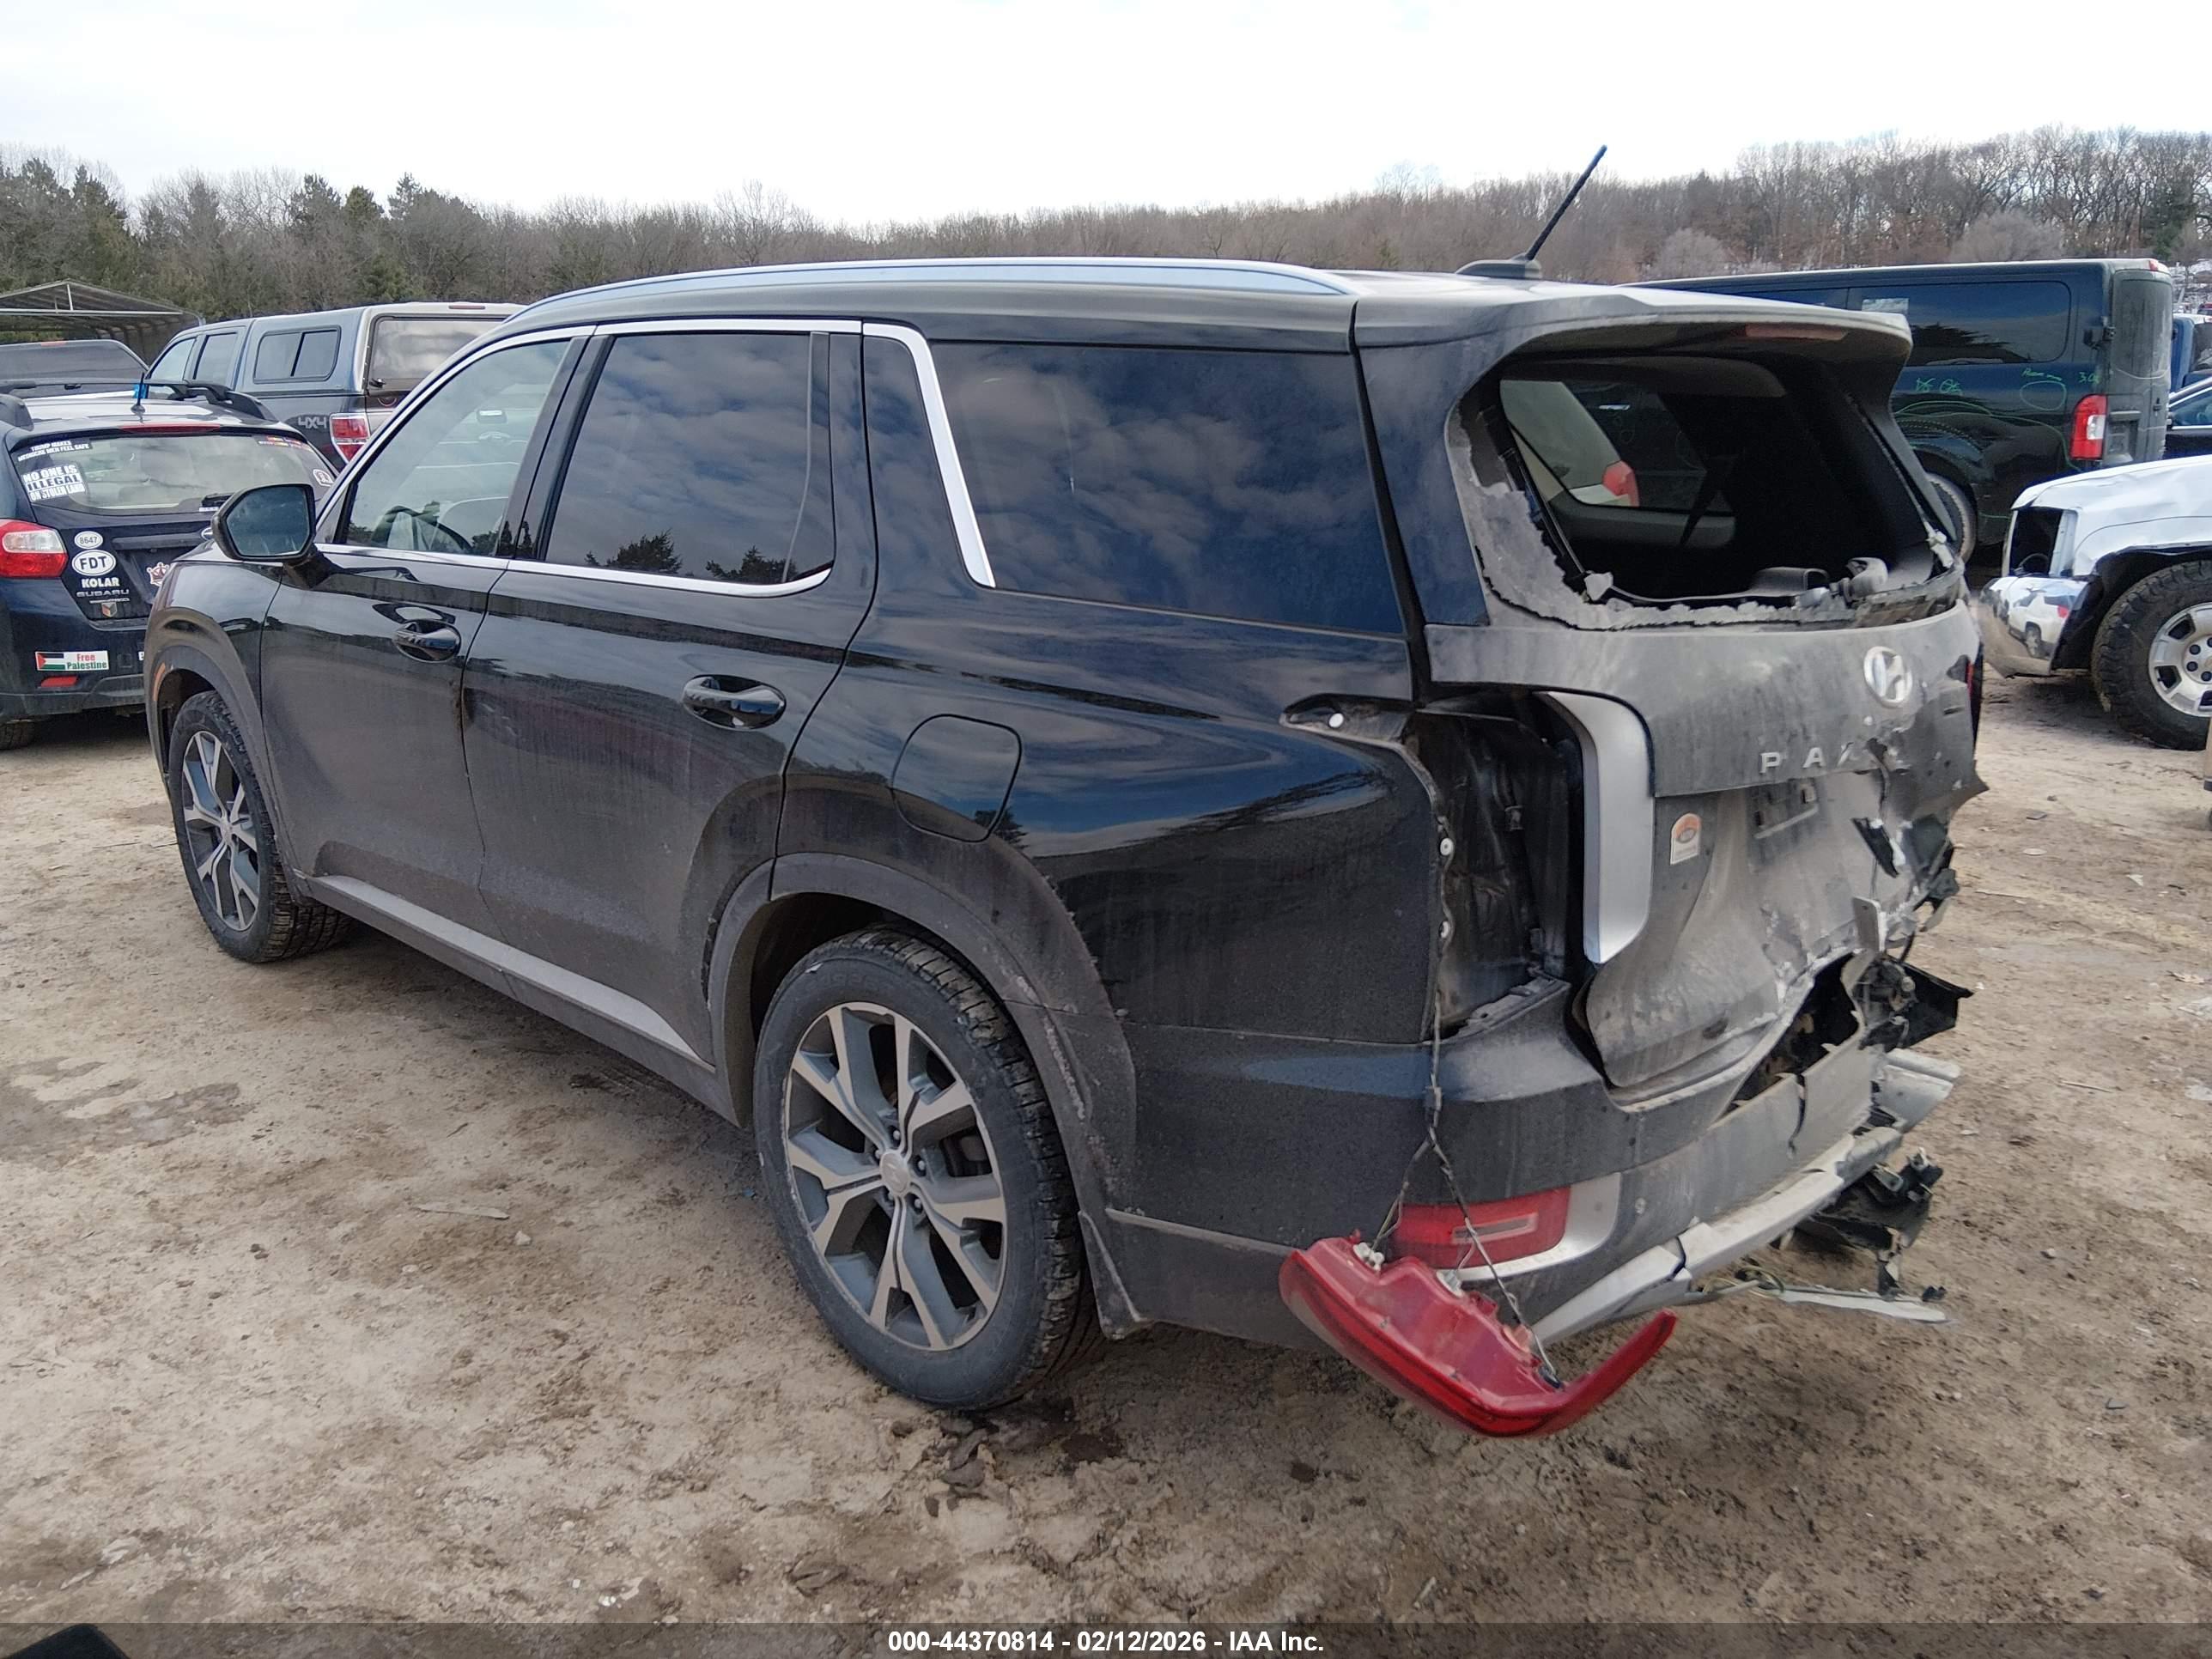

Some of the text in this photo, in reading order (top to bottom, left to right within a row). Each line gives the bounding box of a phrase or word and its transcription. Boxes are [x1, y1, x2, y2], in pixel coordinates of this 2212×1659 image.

[23, 465, 77, 483] NO ONE IS
[27, 474, 81, 490] ILLEGAL
[79, 556, 107, 570] FDT
[82, 577, 120, 588] KOLAR
[67, 661, 107, 670] Palestine
